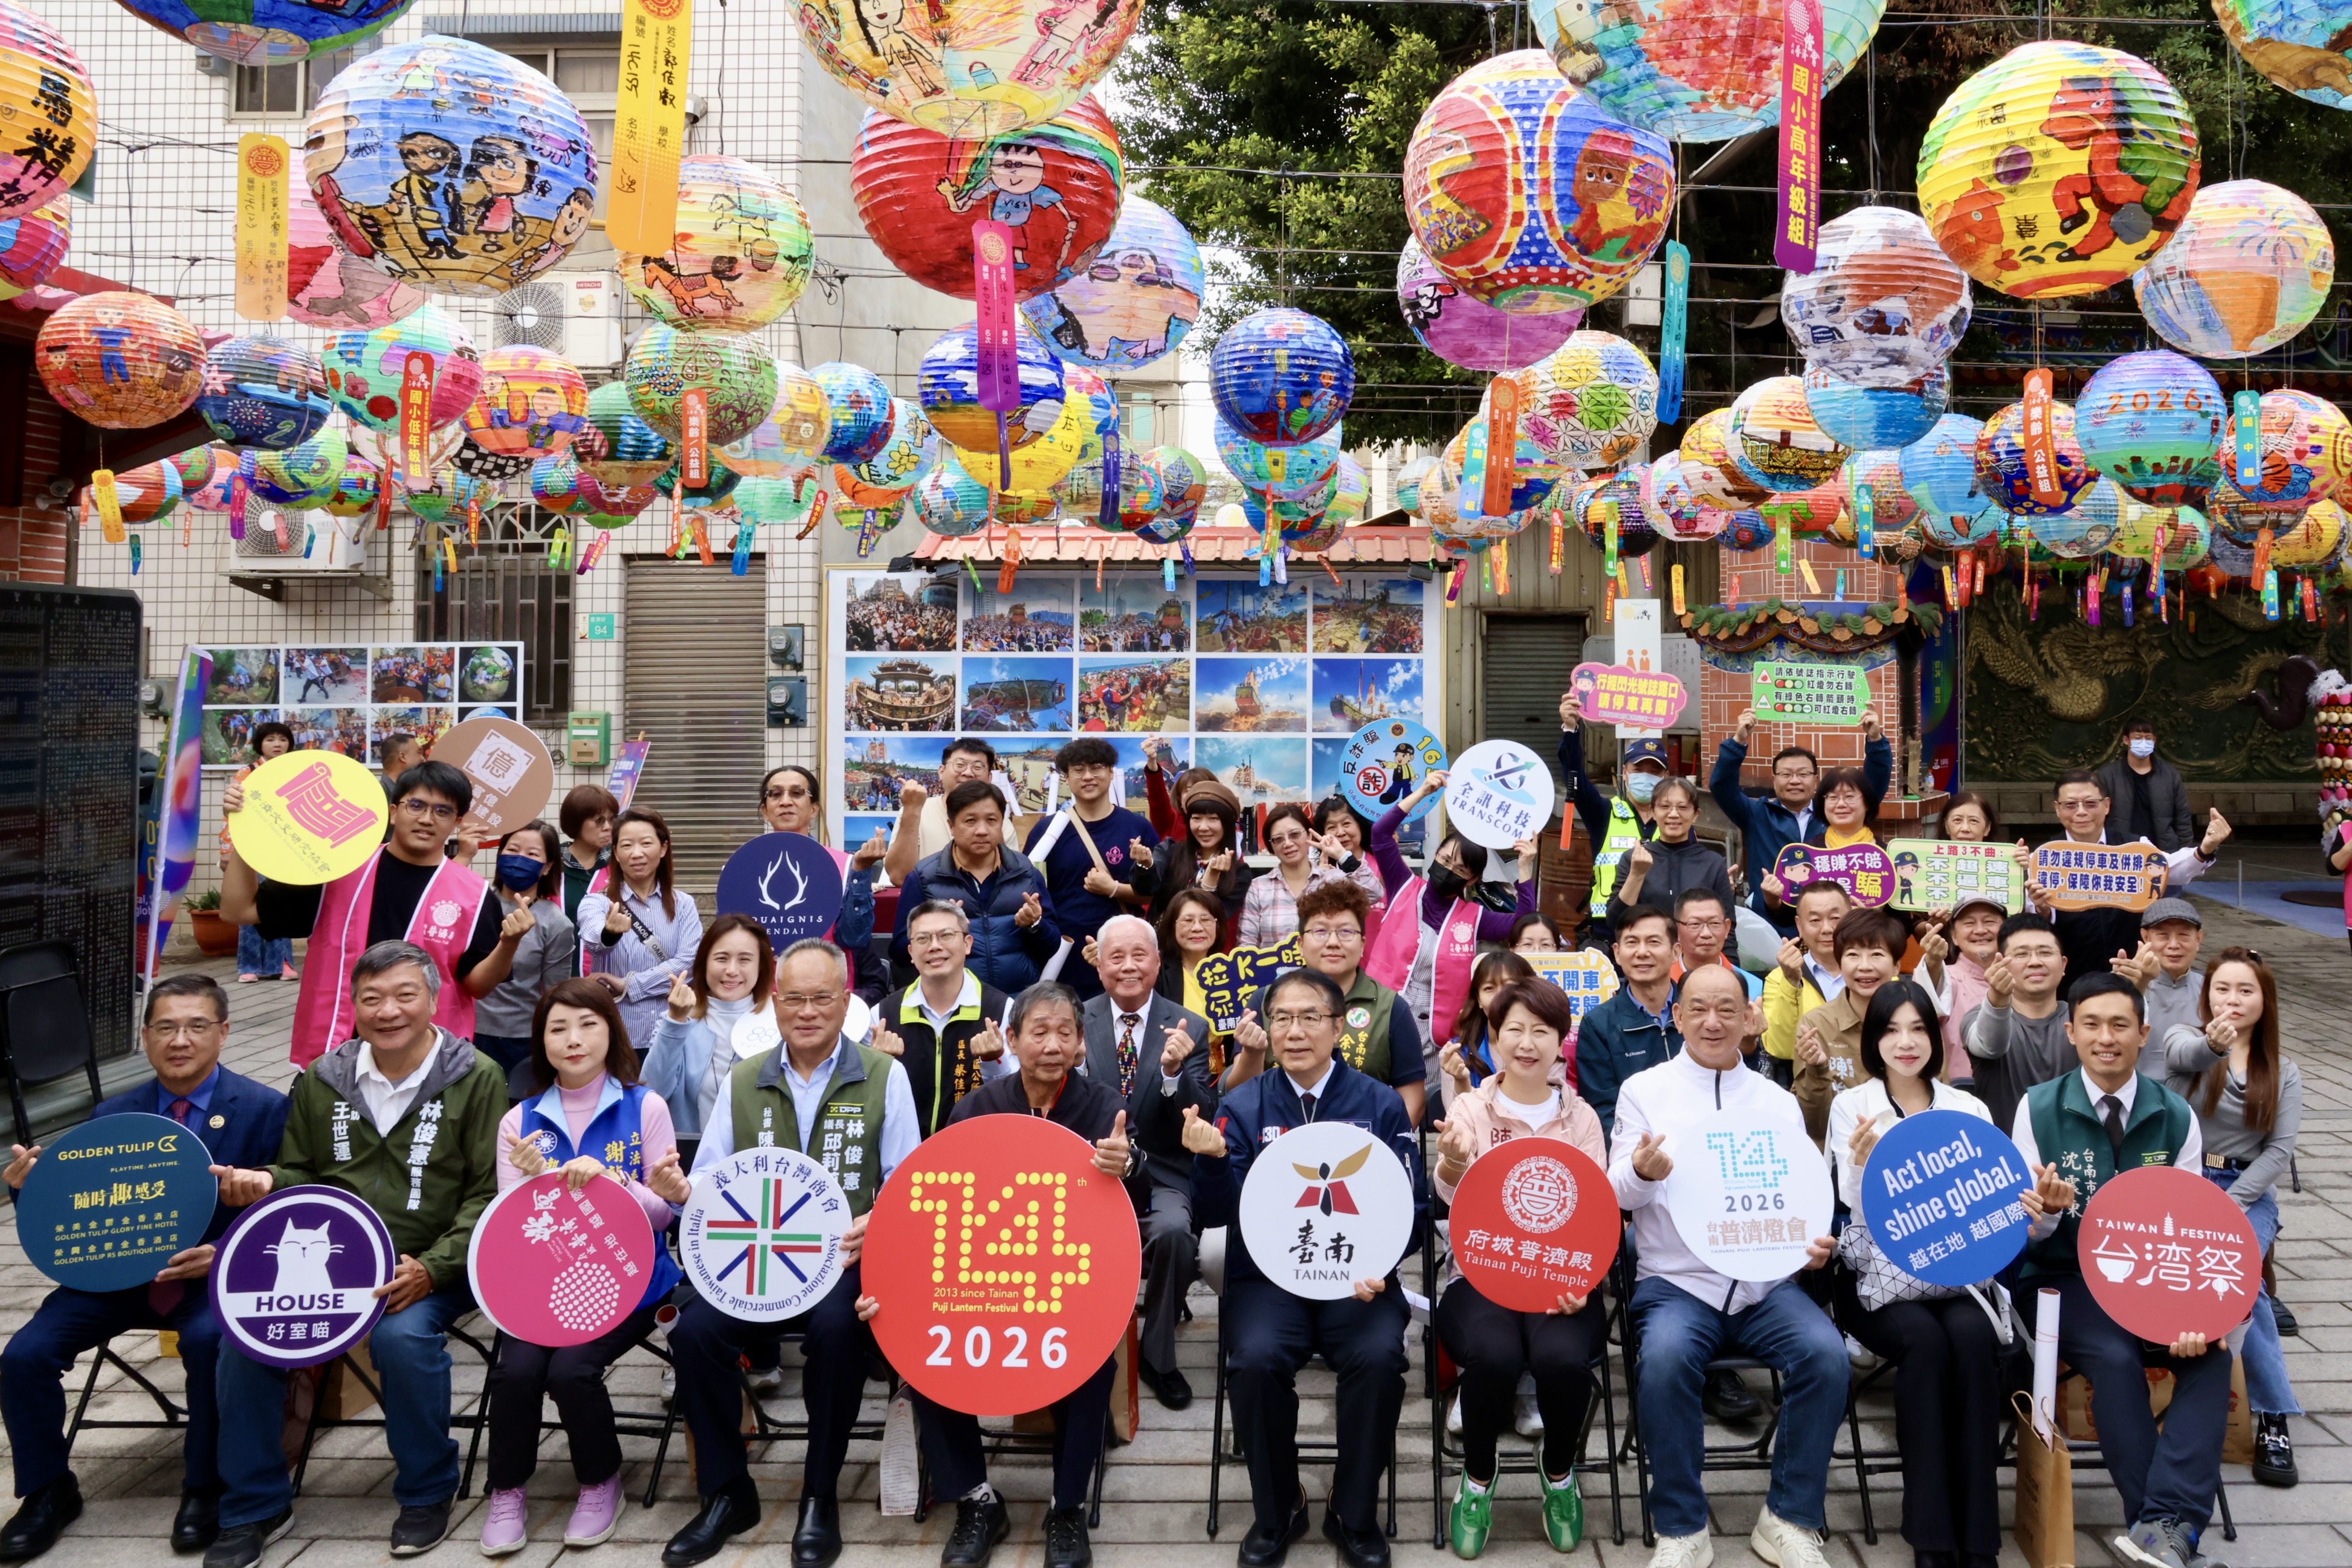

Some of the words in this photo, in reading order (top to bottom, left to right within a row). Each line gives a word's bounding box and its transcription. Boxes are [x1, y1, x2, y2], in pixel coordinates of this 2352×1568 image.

[666, 24, 676, 48] 姓名
[625, 117, 638, 141] 名次
[657, 124, 668, 150] 學校
[1787, 63, 1810, 248] 國小高年級組
[1000, 266, 1007, 282] 姓名
[984, 329, 992, 344] 名次
[1001, 329, 1009, 345] 學校
[407, 389, 423, 477] 國小低年級組
[688, 416, 701, 479] 樂齡/公益組
[2029, 405, 2053, 493] 樂齡/公益組
[2242, 417, 2256, 477] 國中組
[1780, 526, 1788, 568] 成人組
[594, 625, 608, 635] 94
[1596, 673, 1679, 699] 行經閃光號誌路口
[1775, 666, 1864, 680] 請依號誌指示行駛，
[1807, 680, 1861, 691] 紅燈勿右轉。
[1597, 692, 1675, 717] 請停車再開！
[1774, 691, 1863, 705] 有綠色右轉箭頭時，
[1814, 704, 1864, 716] 可紅燈右轉。
[481, 747, 517, 779] 億
[1343, 728, 1381, 776] 反詐騙
[1452, 796, 1523, 840] TRANSCOM
[1456, 781, 1532, 829] 全訊科技
[249, 789, 331, 873] 普濟文史研究協會
[1814, 851, 1882, 873] 穩賺不賠
[1926, 857, 2010, 875] 不超速
[2038, 849, 2144, 873] 請勿違規停車及併排
[1201, 943, 1307, 987] 拉K一時
[957, 1039, 966, 1060] 區長
[1354, 1031, 1369, 1073] 台南市
[763, 1106, 773, 1129] 秘書
[823, 1118, 845, 1130] 議長
[332, 1101, 352, 1163] 王世運
[406, 1100, 444, 1167] 林俊憲
[58, 1146, 114, 1161] GOLDEN
[117, 1141, 155, 1153] TULIP
[842, 1118, 865, 1192] 林俊憲
[1881, 1149, 1924, 1198] Act
[1924, 1128, 1984, 1179] local,
[2205, 1152, 2225, 1169] DIOR
[110, 1164, 146, 1173] PLAYTIME.
[148, 1160, 180, 1169] ANYTIME.
[71, 1179, 166, 1210] 隨時趣感受
[406, 1167, 423, 1211] 服務團隊
[711, 1155, 840, 1214] 義大利台灣商會
[1076, 1176, 1088, 1187] th
[1724, 1192, 1785, 1213] 2026
[1884, 1192, 1947, 1242] shine
[1945, 1155, 2022, 1224] global.
[55, 1232, 86, 1242] GOLDEN
[88, 1229, 109, 1237] TULIP
[110, 1225, 135, 1234] GLORY
[155, 1220, 178, 1228] HOTEL
[569, 1188, 605, 1230] 越國際
[604, 1233, 639, 1277] 越在地
[687, 1207, 705, 1237] Italia
[1707, 1221, 1720, 1247] 台南
[1719, 1216, 1807, 1247] 普濟燈會
[2096, 1218, 2159, 1234] TAIWAN
[2180, 1227, 2244, 1244] FESTIVAL
[688, 1239, 700, 1251] in
[1288, 1219, 1355, 1265] 臺南
[1907, 1230, 1968, 1272] 越在地
[1968, 1199, 2028, 1243] 越國際
[53, 1256, 85, 1266] GOLDEN
[85, 1253, 106, 1261] TULIP
[117, 1247, 153, 1257] BOUTIQUE
[155, 1244, 178, 1253] HOTEL
[1464, 1229, 1594, 1272] 府城普濟殿
[696, 1255, 729, 1305] Taiwanese
[801, 1233, 842, 1301] Associazione
[1293, 1268, 1350, 1282] TAINAN
[1464, 1251, 1507, 1271] Tainan
[1511, 1259, 1538, 1278] Puji
[1542, 1266, 1589, 1288] Temple
[2091, 1234, 2246, 1302] 台湾祭
[256, 1292, 346, 1313] HOUSE
[729, 1294, 802, 1313] Commerciale
[933, 1287, 958, 1298] 2013
[960, 1288, 985, 1298] since
[988, 1288, 1019, 1299] Tainan
[932, 1302, 949, 1314] Puji
[950, 1302, 983, 1313] Lantern
[985, 1302, 1019, 1313] Festival
[267, 1321, 331, 1341] 好室喵
[925, 1324, 1068, 1369] 2026
